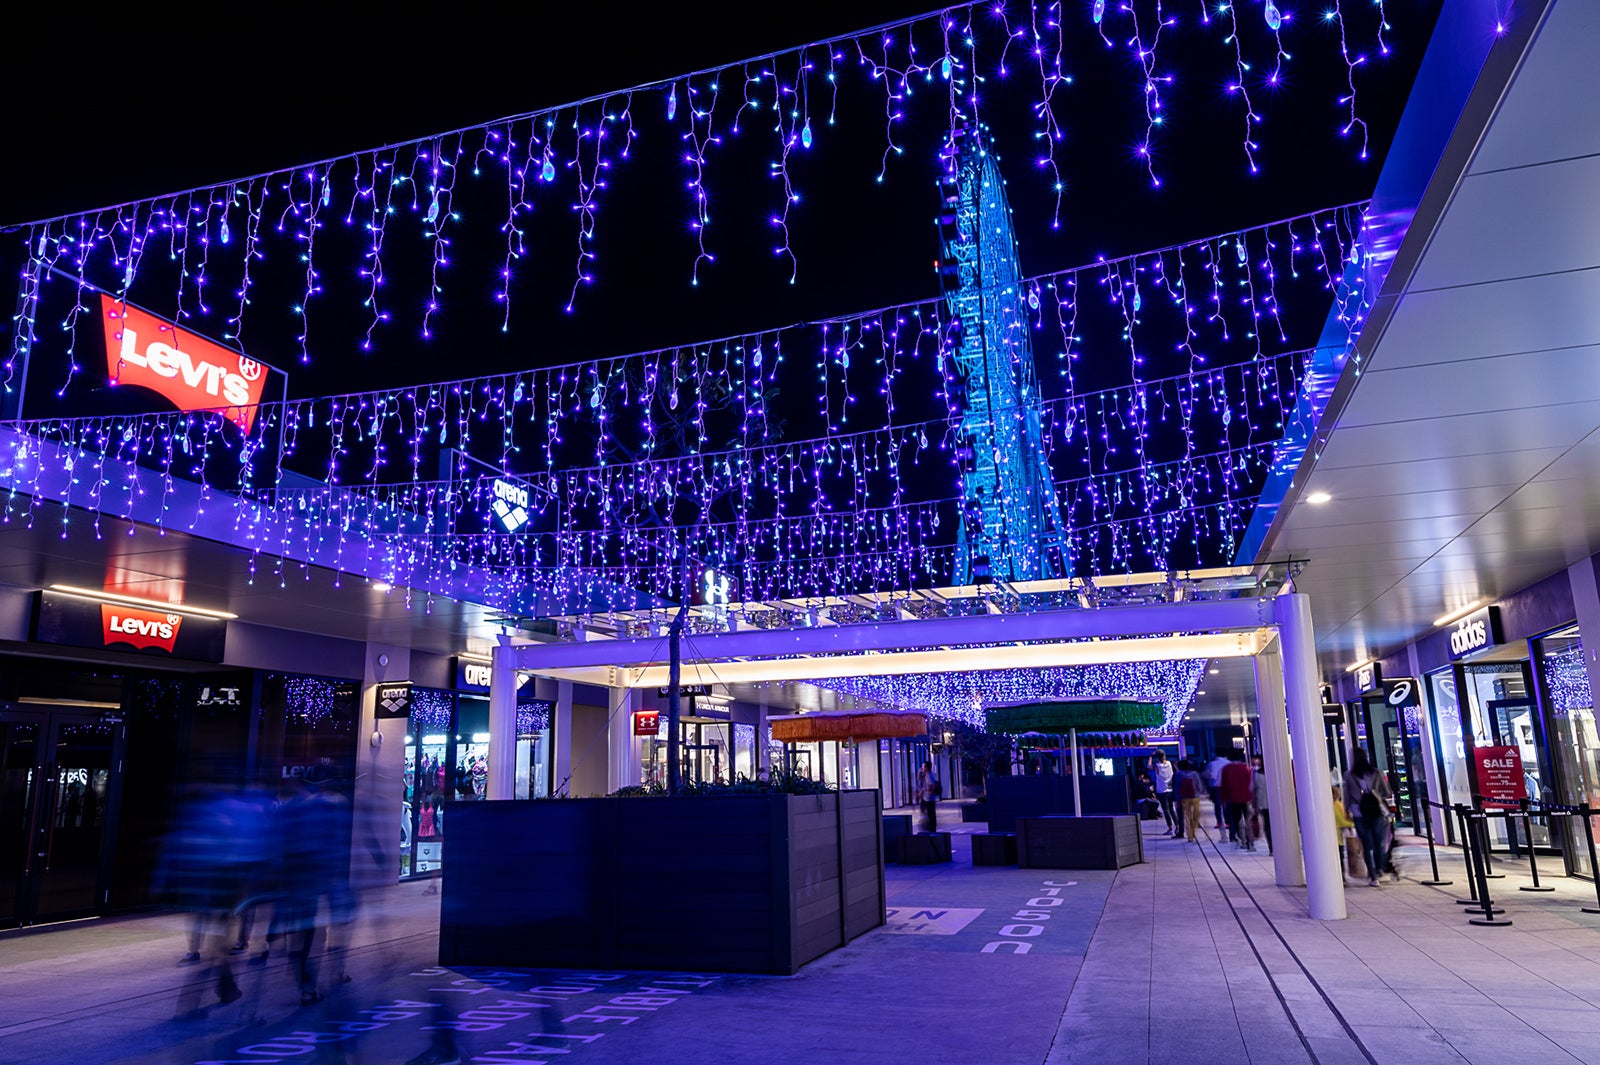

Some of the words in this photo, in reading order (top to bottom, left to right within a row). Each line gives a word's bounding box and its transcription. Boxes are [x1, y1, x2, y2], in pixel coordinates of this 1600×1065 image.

[120, 327, 249, 406] Levi's
[494, 478, 528, 508] arena
[110, 615, 173, 639] Levi's
[1451, 618, 1487, 656] adidas
[465, 664, 492, 687] are
[382, 687, 408, 699] arena
[1483, 758, 1514, 768] SALE
